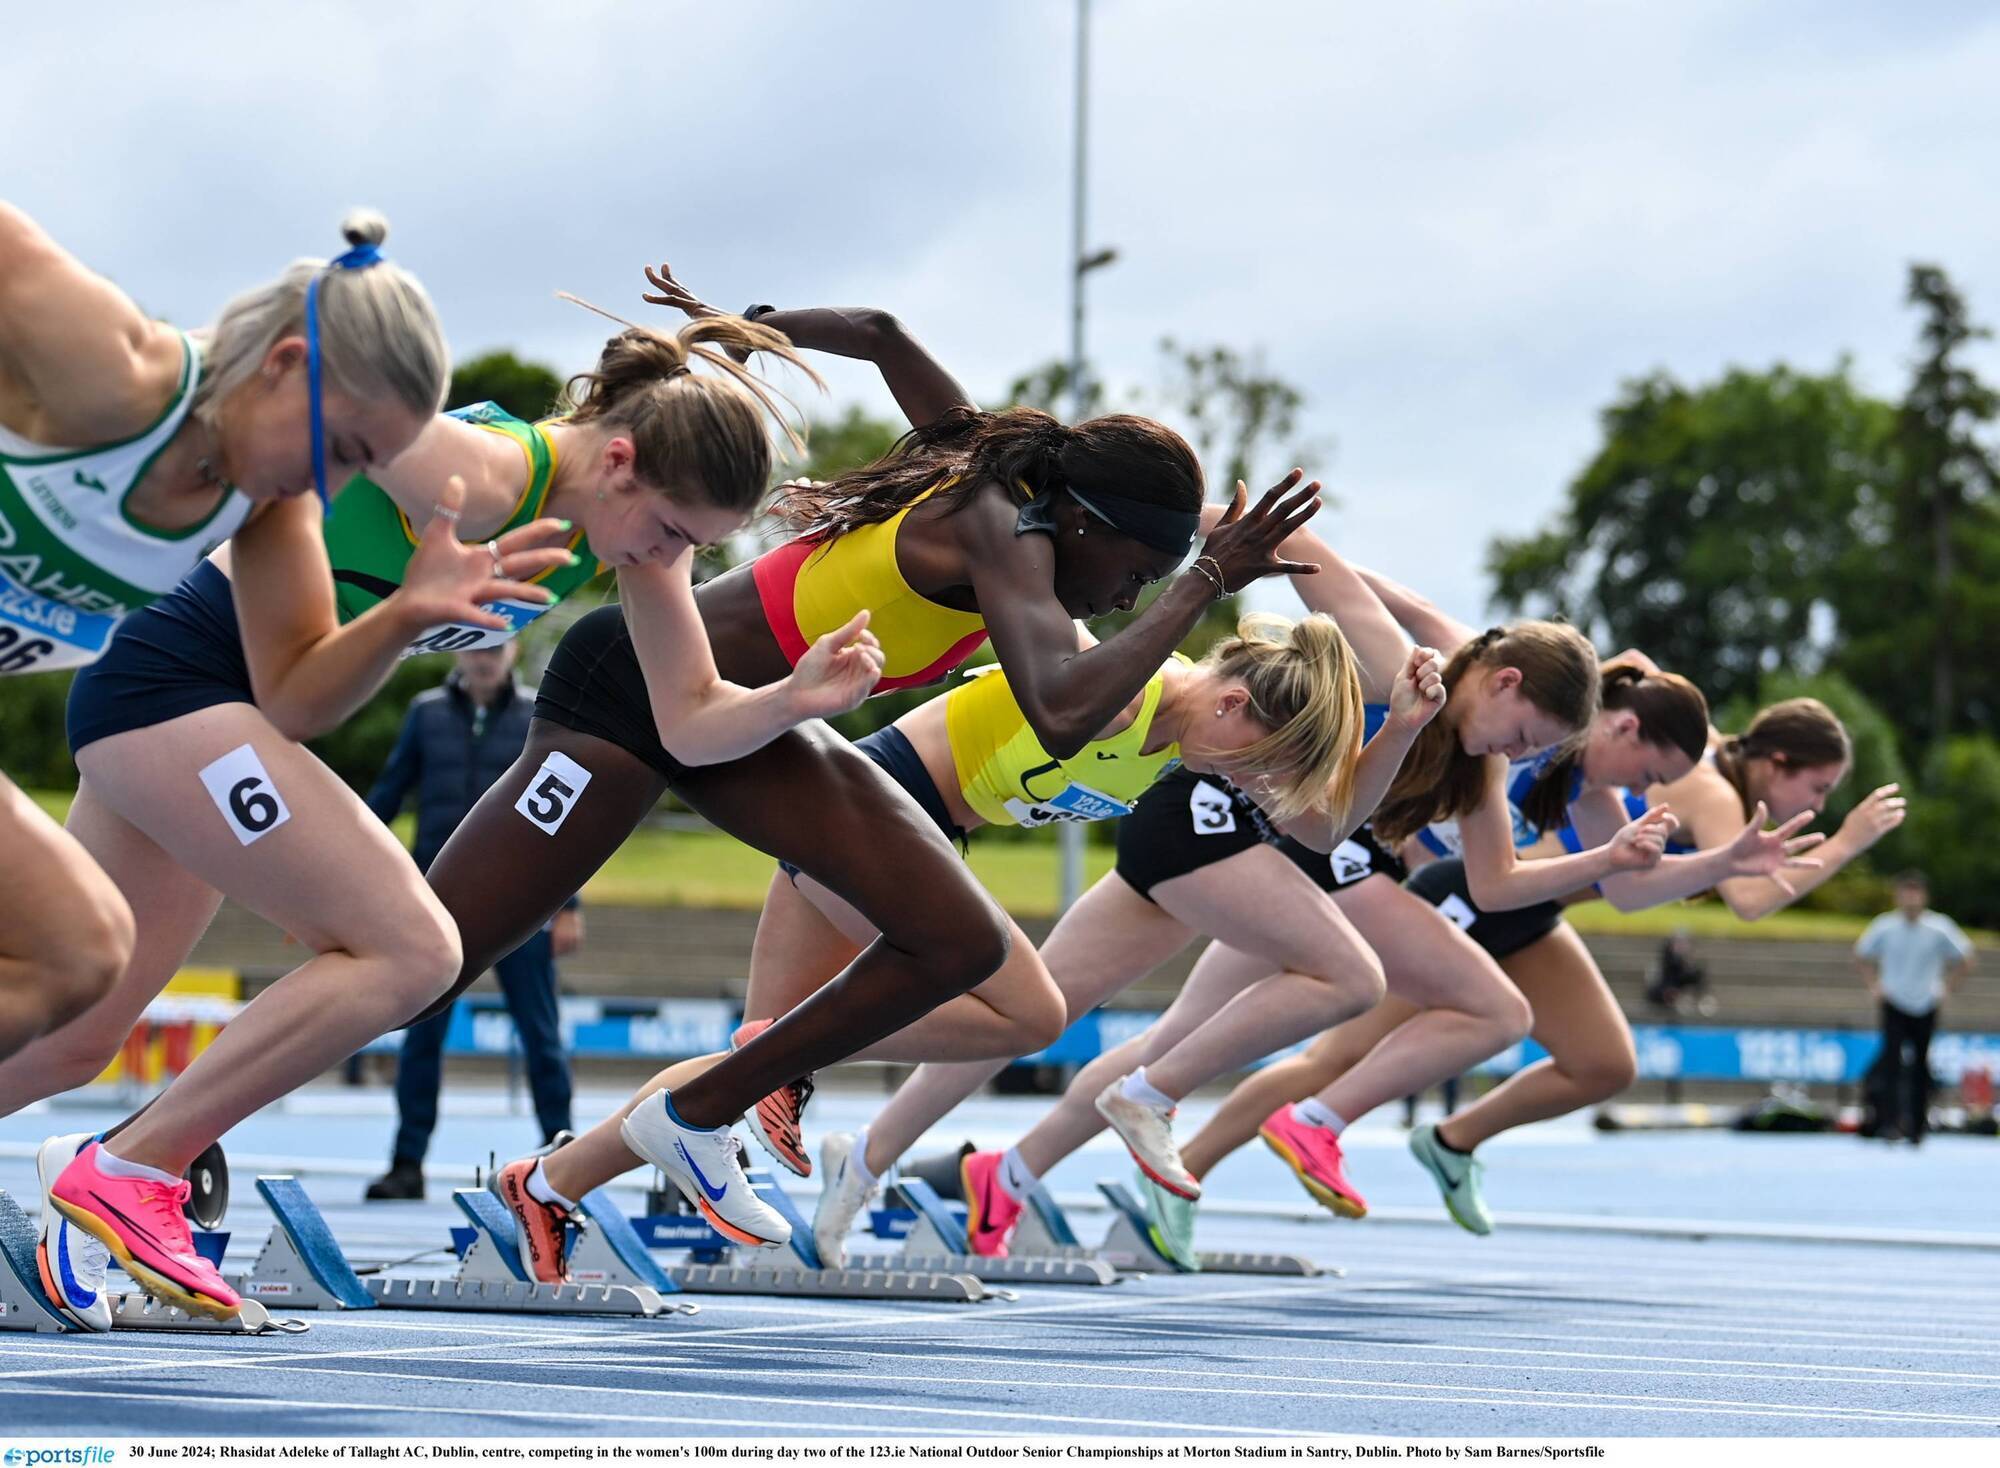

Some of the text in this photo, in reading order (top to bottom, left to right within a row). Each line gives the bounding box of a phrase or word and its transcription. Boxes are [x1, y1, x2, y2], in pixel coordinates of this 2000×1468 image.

[229, 777, 279, 832] 6
[527, 773, 575, 824] 5
[1070, 794, 1115, 817] 123.ie
[1198, 801, 1228, 828] 3
[507, 1173, 540, 1262] new balance
